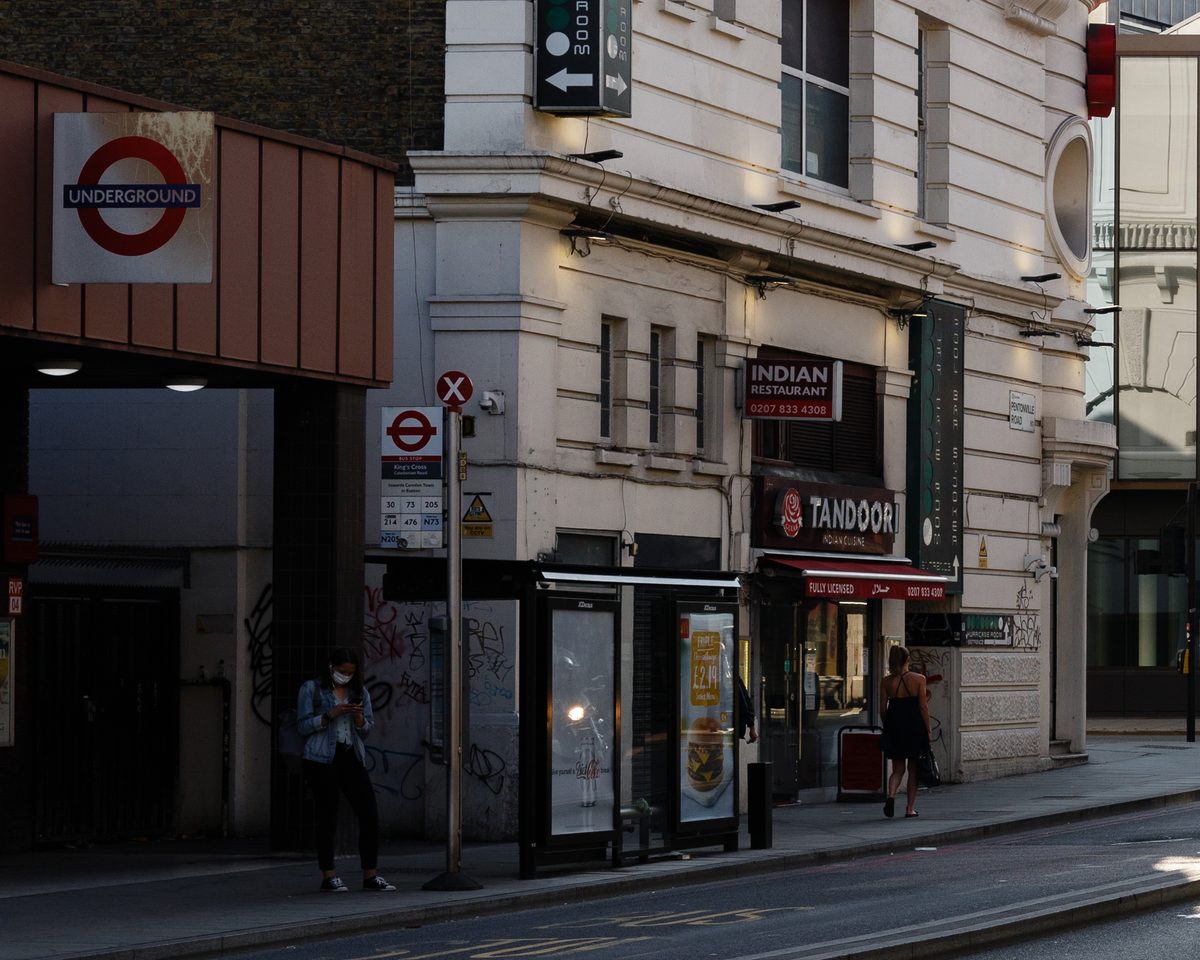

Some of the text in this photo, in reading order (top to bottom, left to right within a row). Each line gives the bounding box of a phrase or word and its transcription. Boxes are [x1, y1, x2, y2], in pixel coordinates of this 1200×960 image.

[574, 0, 590, 55] ROOM
[618, 7, 627, 61] ROOM
[69, 188, 197, 204] UNDERGROUND
[751, 364, 829, 383] INDIAN
[443, 376, 466, 401] X
[751, 385, 828, 397] RESTAURANT
[750, 403, 827, 415] 0207 833 4308
[1011, 401, 1035, 415] PENTONVILLE
[1011, 414, 1023, 425] ROAD
[810, 496, 900, 534] TANDOORI
[384, 518, 397, 526] 214
[423, 518, 440, 526] N73
[822, 534, 843, 545] INDIAN
[9, 581, 23, 594] RVP
[809, 582, 855, 594] FULLY LICENSED
[907, 586, 920, 597] 0207
[921, 587, 930, 597] 833
[11, 598, 19, 611] 04
[692, 665, 717, 689] £2.19
